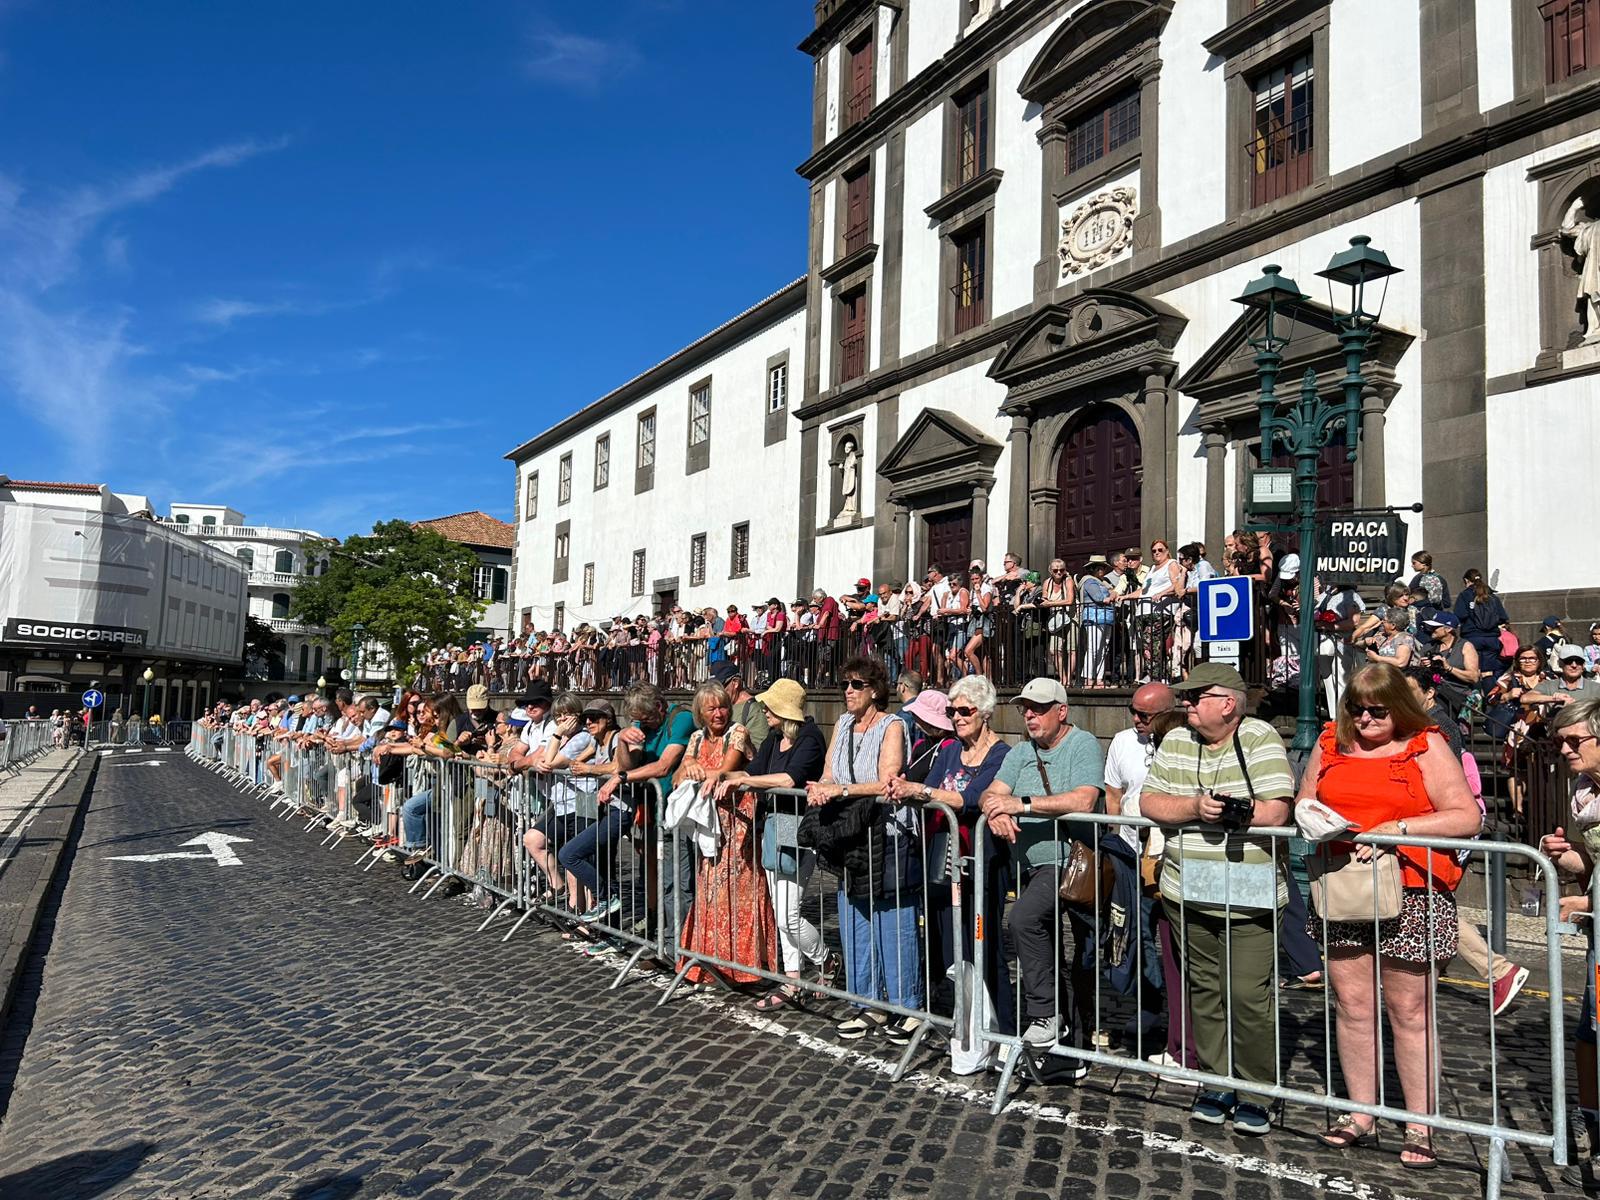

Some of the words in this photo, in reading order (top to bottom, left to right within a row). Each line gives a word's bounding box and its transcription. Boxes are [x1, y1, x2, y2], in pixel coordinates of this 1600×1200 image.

[1331, 521, 1388, 537] PRAÇA
[1348, 541, 1367, 553] DO
[1316, 553, 1399, 573] MUNICÍPIO
[1208, 583, 1239, 636] P
[17, 624, 143, 645] SOCICORREIA
